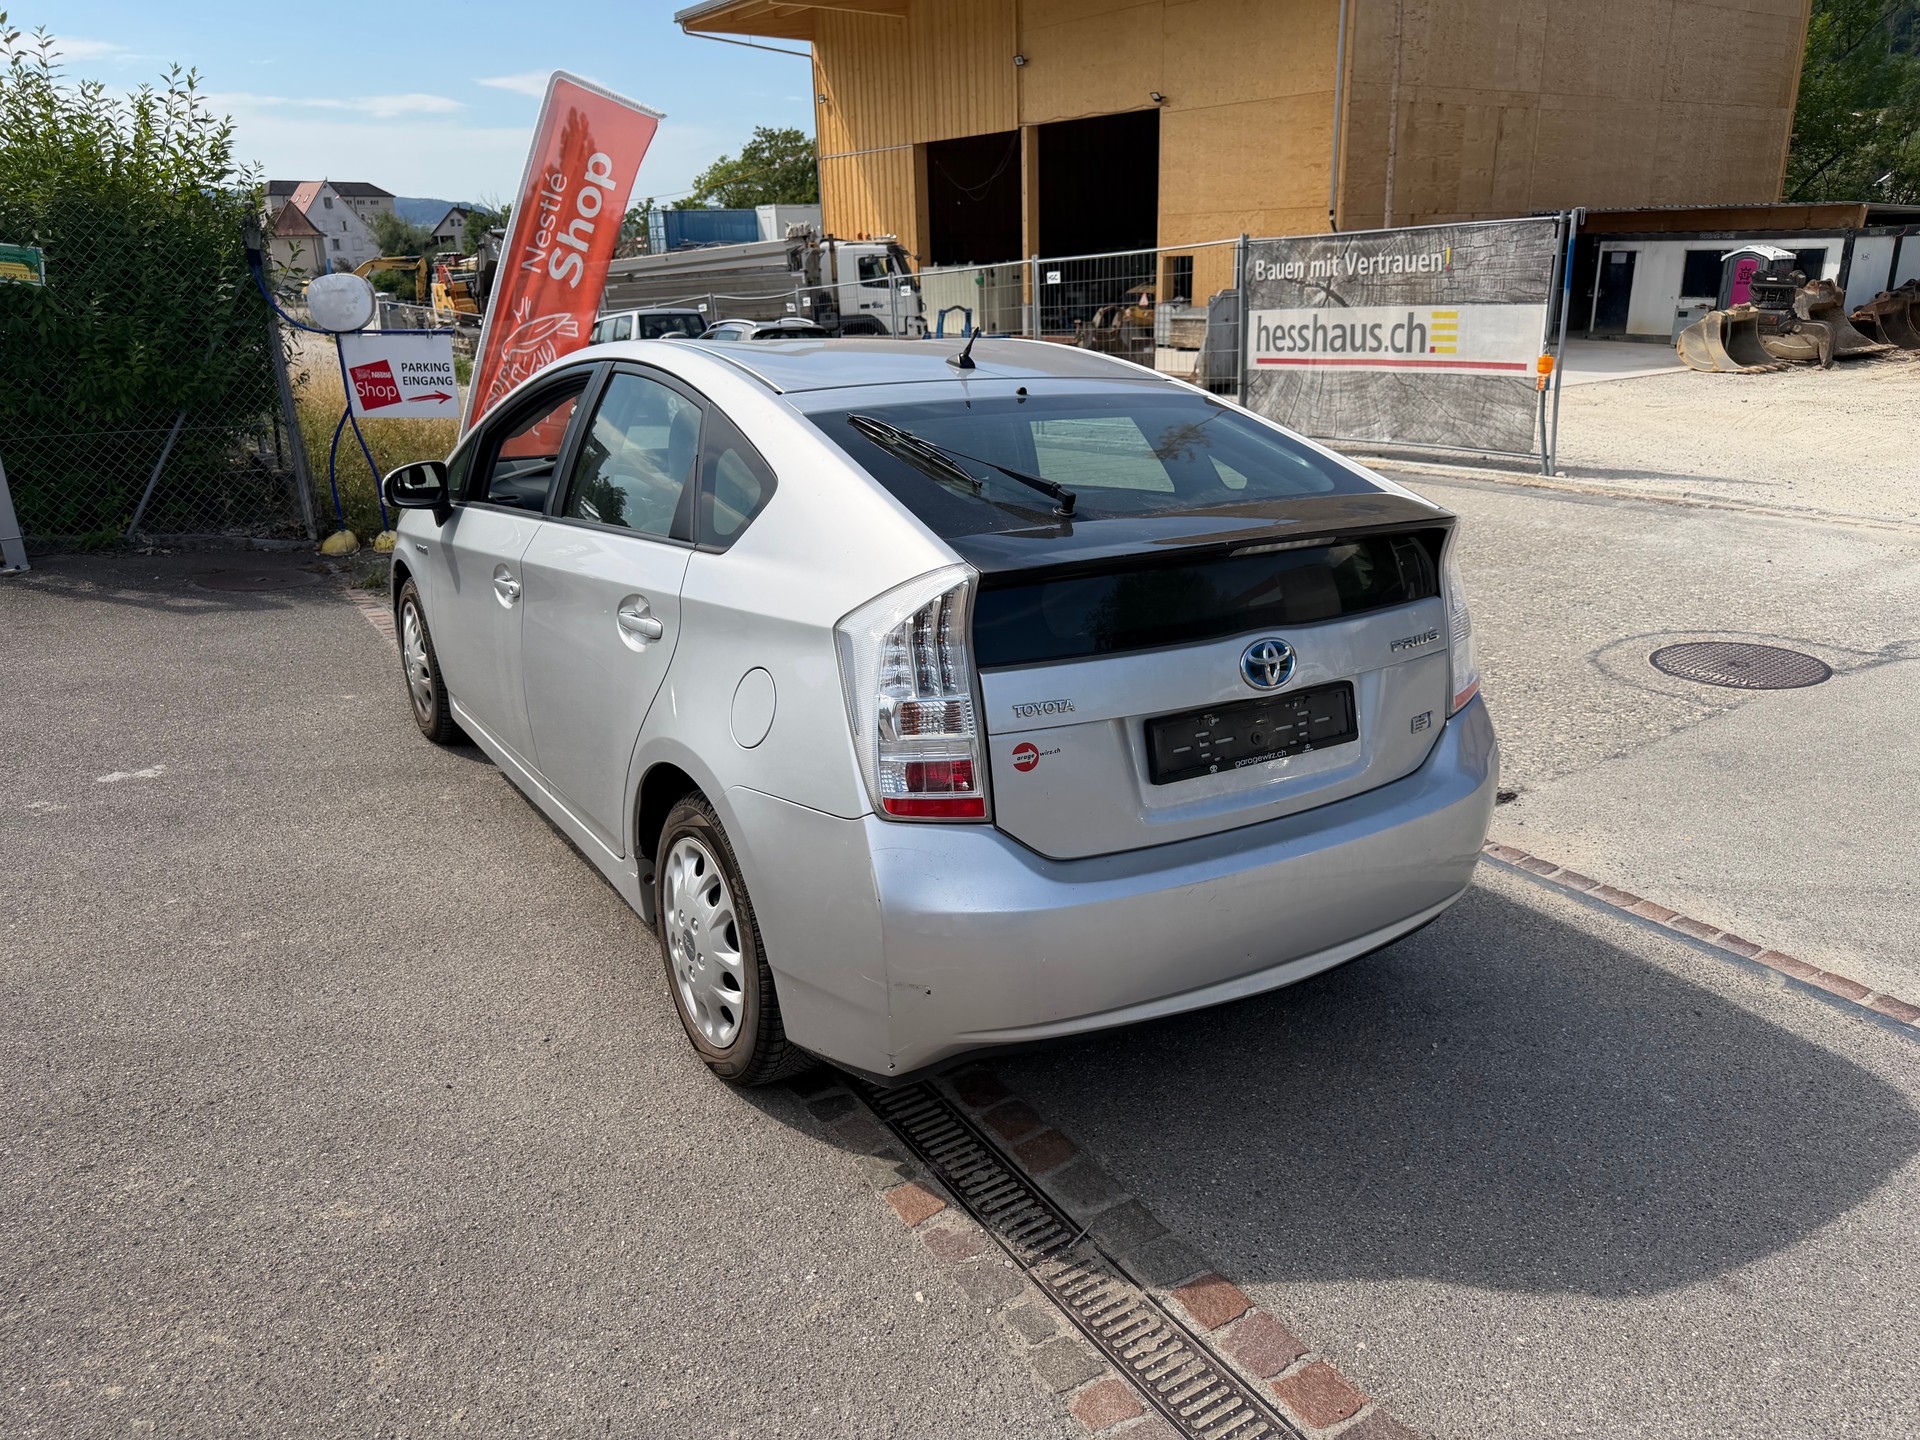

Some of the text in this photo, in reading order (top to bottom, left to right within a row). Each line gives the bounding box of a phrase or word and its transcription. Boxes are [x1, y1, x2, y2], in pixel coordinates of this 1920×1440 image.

[521, 172, 567, 274] Nestlé
[548, 152, 617, 289] Shop
[1255, 247, 1451, 281] Bauen mit Vertrauen!
[1256, 312, 1427, 354] hesshaus.ch
[401, 362, 450, 372] PARKING
[356, 381, 397, 400] Shop
[403, 376, 453, 386] EINGANG
[1390, 629, 1440, 653] PRIUS
[1012, 699, 1076, 718] TOYOTA
[1235, 749, 1287, 769] garagewirz.ch
